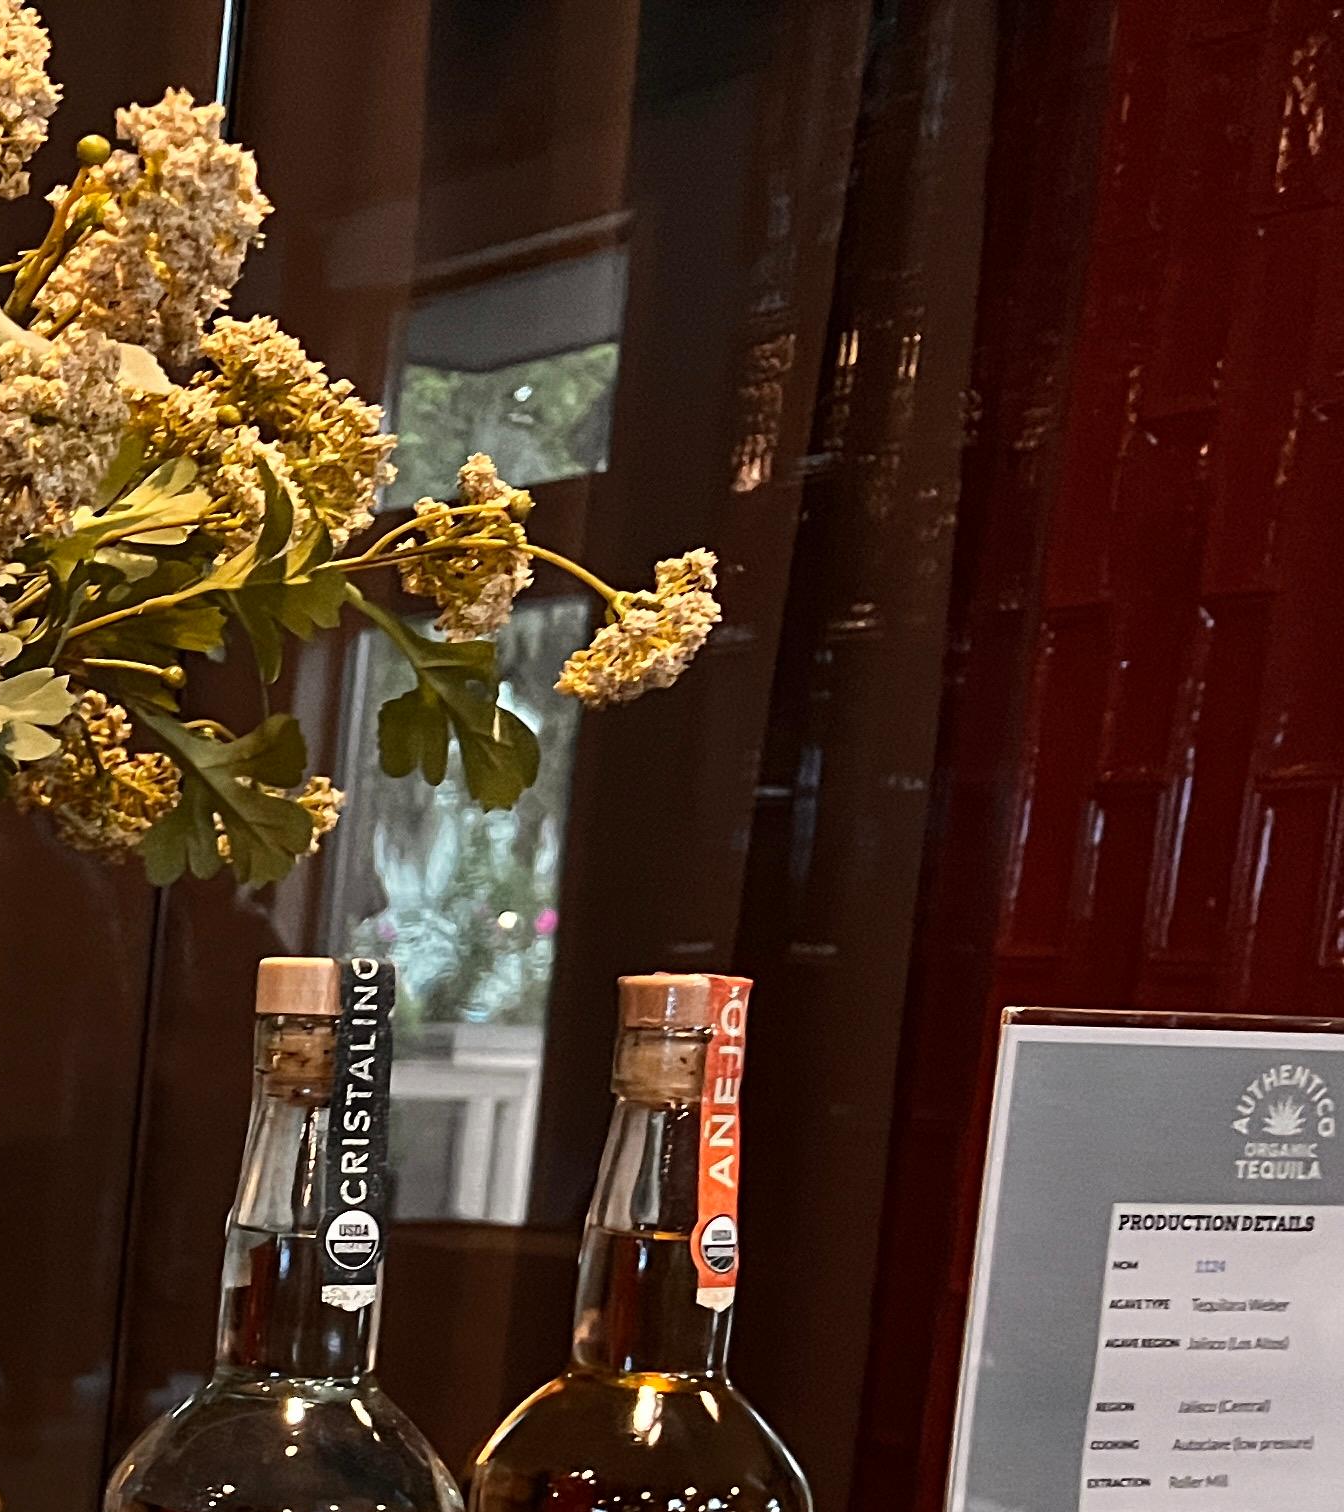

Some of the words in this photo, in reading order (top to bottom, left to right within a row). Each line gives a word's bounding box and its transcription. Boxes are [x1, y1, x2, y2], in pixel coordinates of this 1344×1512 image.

[339, 957, 380, 1206] CRISTALINO
[704, 997, 745, 1189] AÑEJO
[1232, 1064, 1336, 1138] AUTHENTICO
[1235, 1159, 1322, 1179] TEQUILA
[1118, 1215, 1240, 1232] PRODUCTION
[1241, 1215, 1315, 1232] DETAILS
